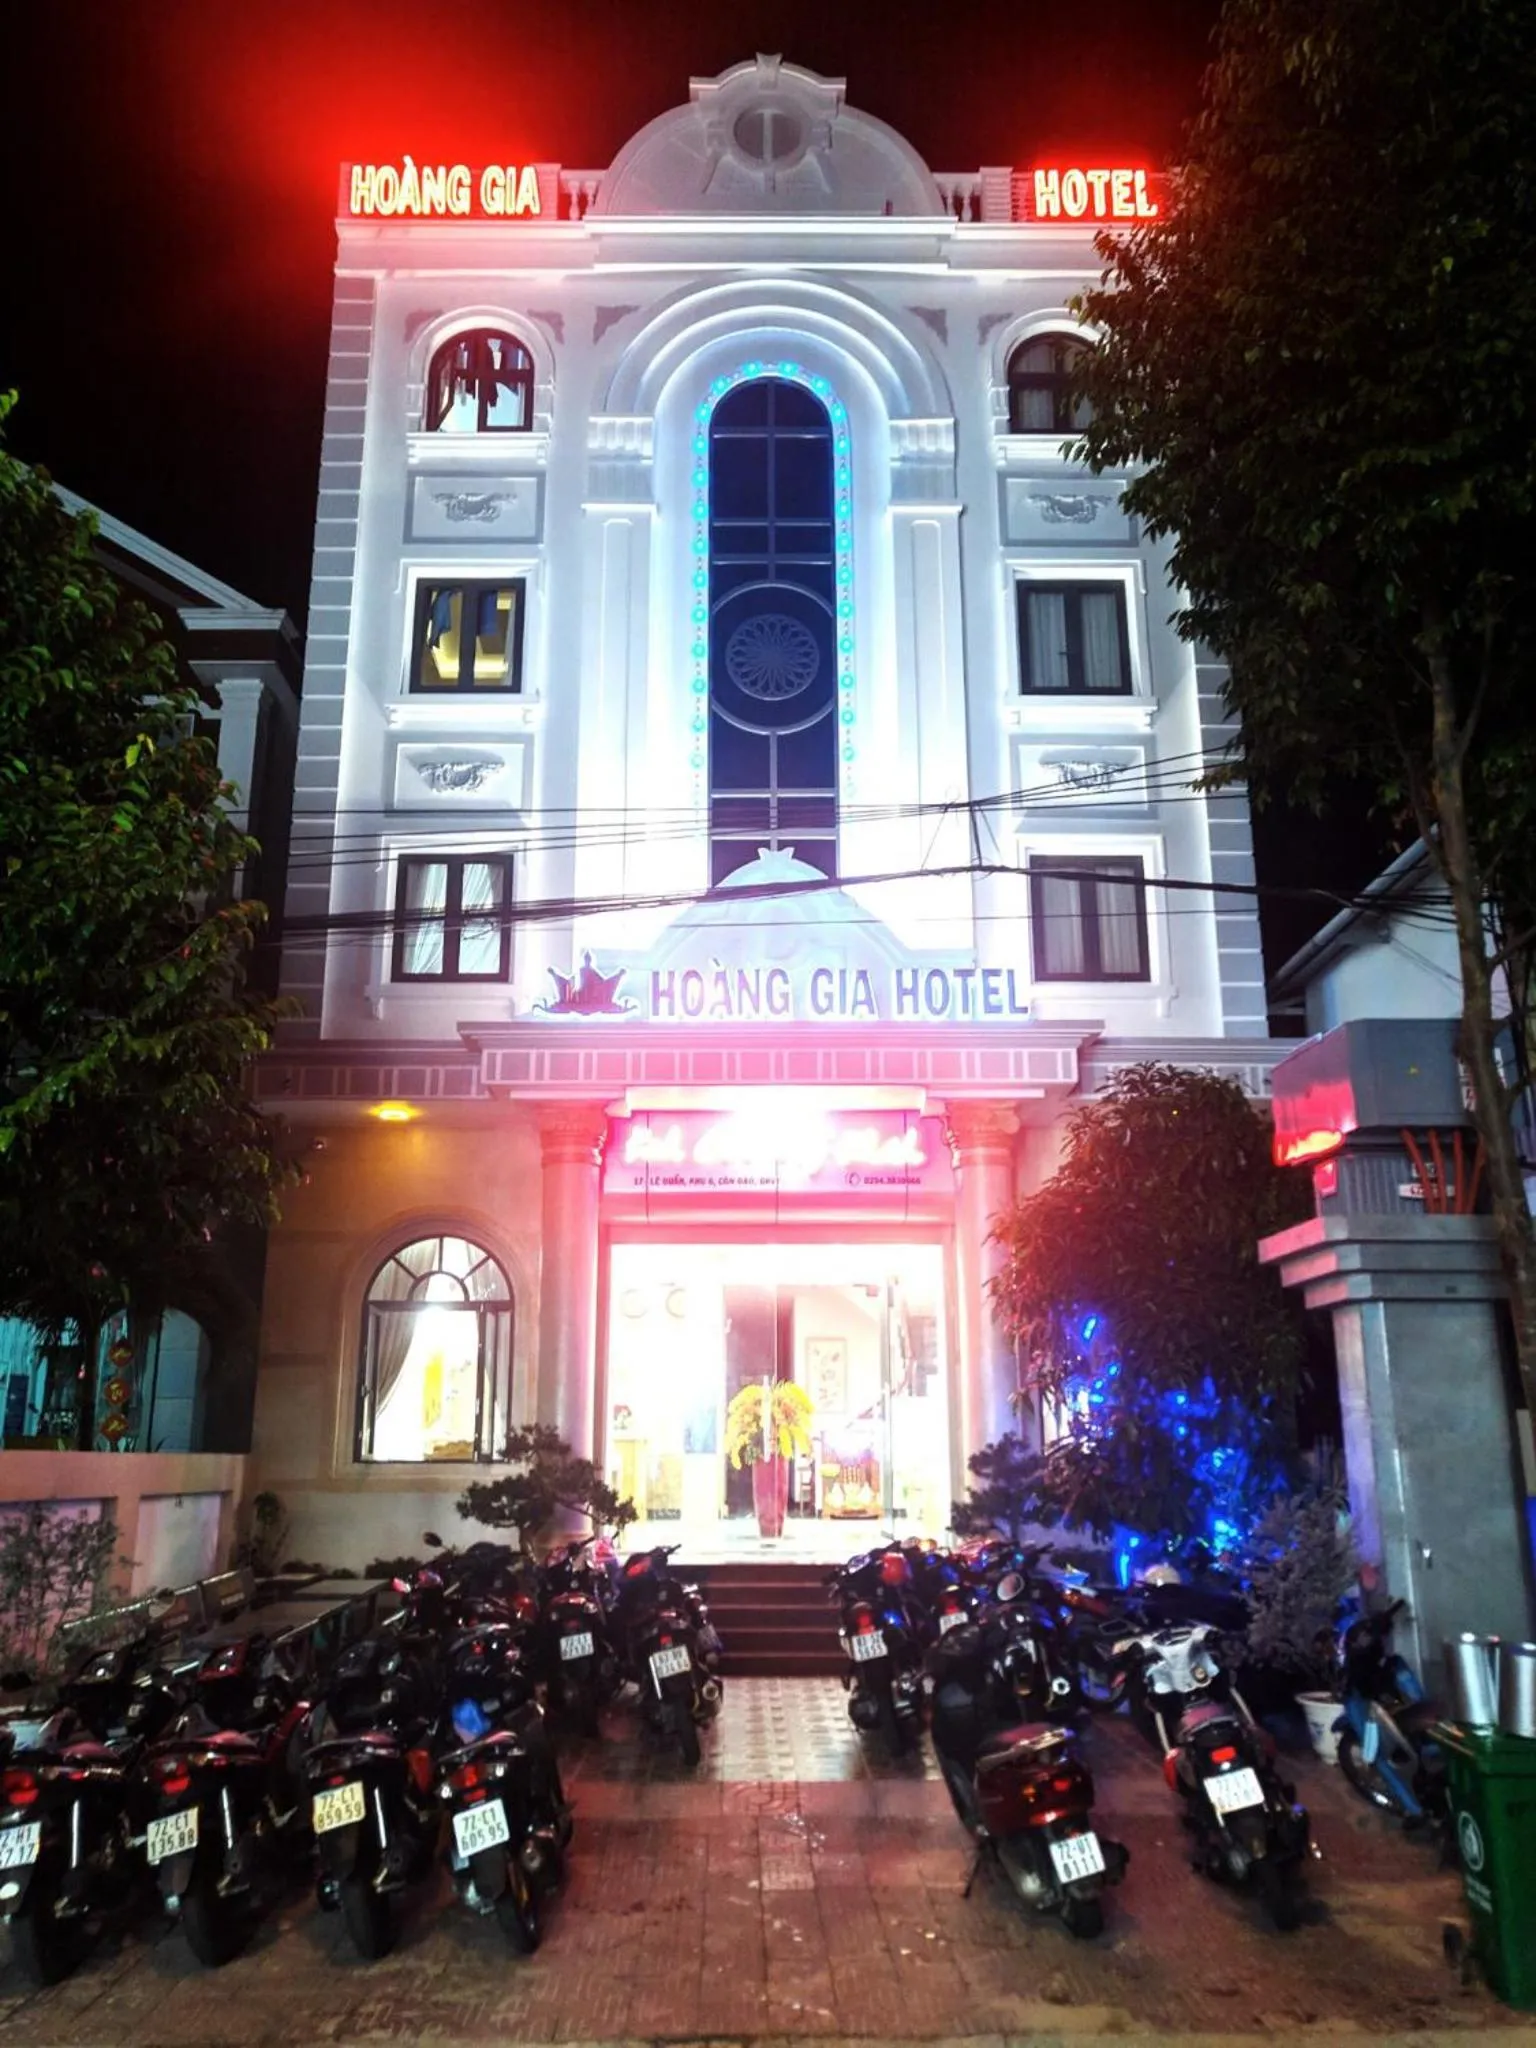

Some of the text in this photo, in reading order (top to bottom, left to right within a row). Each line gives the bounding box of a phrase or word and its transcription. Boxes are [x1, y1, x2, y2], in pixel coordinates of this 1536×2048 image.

[350, 155, 541, 216] HOÀNG GIA
[1034, 168, 1158, 217] HOTEL
[651, 957, 1029, 1017] HOÀNG GIA HOTEL
[1063, 1853, 1099, 1880] 0111
